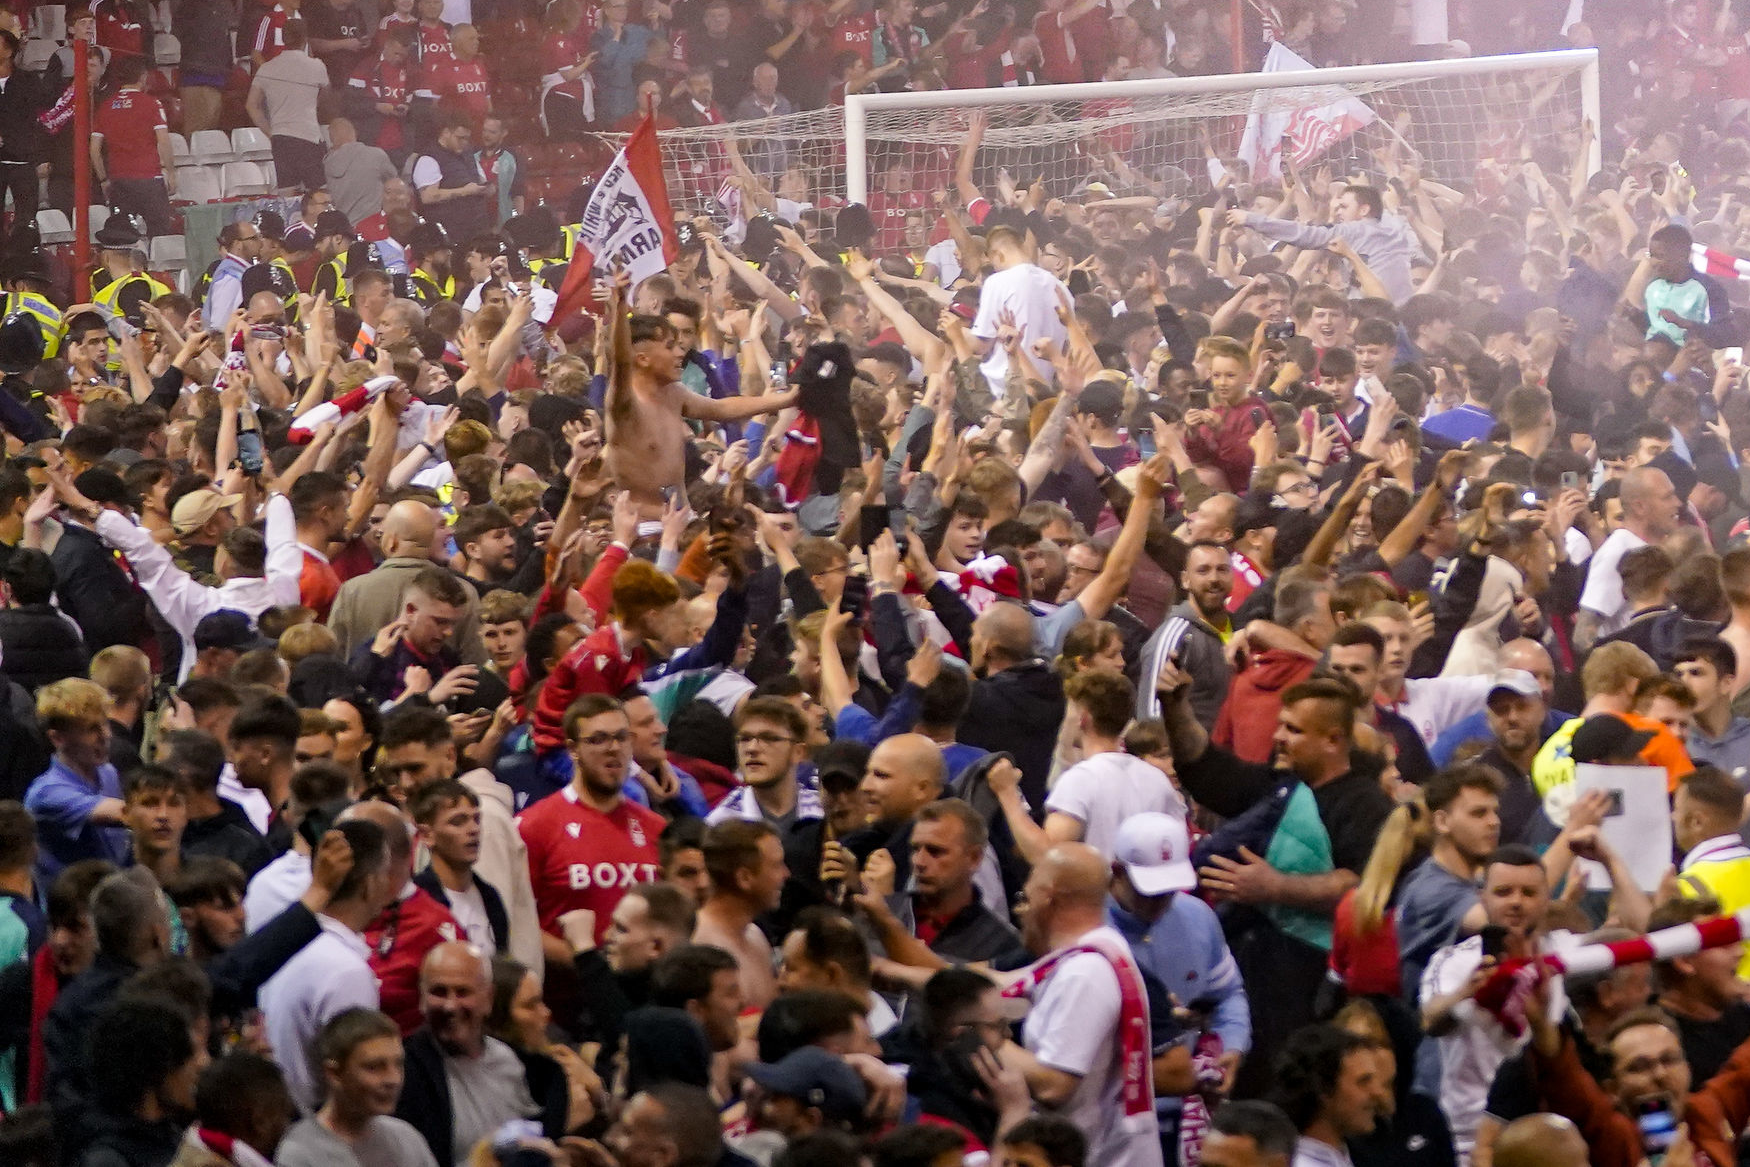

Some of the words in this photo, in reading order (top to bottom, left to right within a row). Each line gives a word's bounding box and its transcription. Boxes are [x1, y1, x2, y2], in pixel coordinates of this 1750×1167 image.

[383, 87, 405, 98] OXT
[456, 82, 486, 93] BOXT
[887, 208, 905, 217] BO
[569, 862, 657, 889] BOXT
